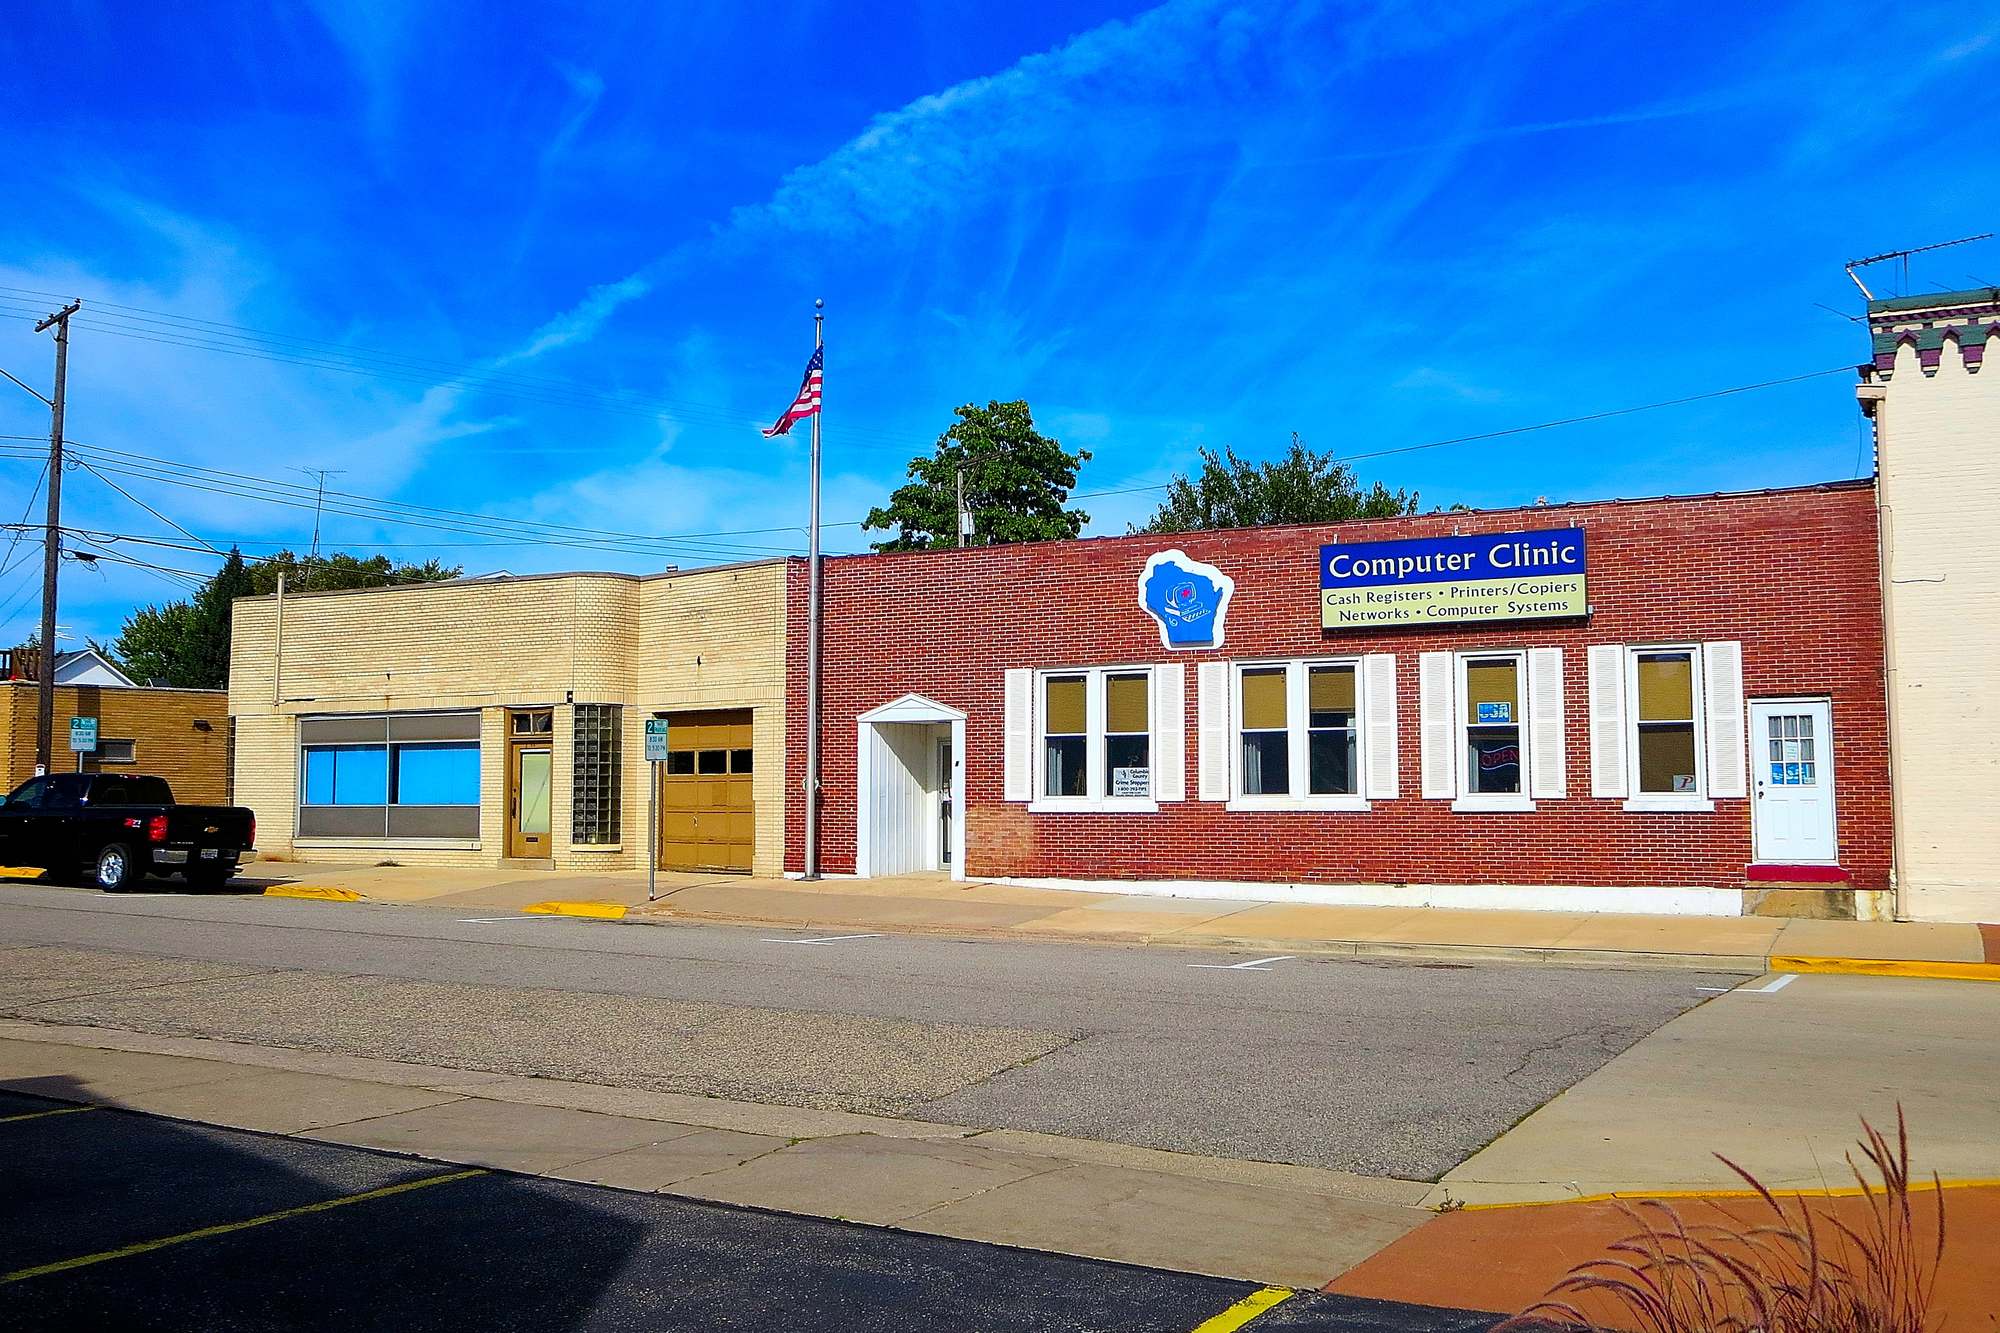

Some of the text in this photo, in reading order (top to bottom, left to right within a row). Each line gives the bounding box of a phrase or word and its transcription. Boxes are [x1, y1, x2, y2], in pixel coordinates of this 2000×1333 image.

[1329, 541, 1576, 578] Computer Clinic
[1326, 582, 1577, 606] Cash Registers Printers/Copiers
[1339, 600, 1569, 622] Networks Computer Systems
[72, 719, 80, 729] 2
[647, 721, 653, 733] 2
[1480, 750, 1519, 766] OPEN
